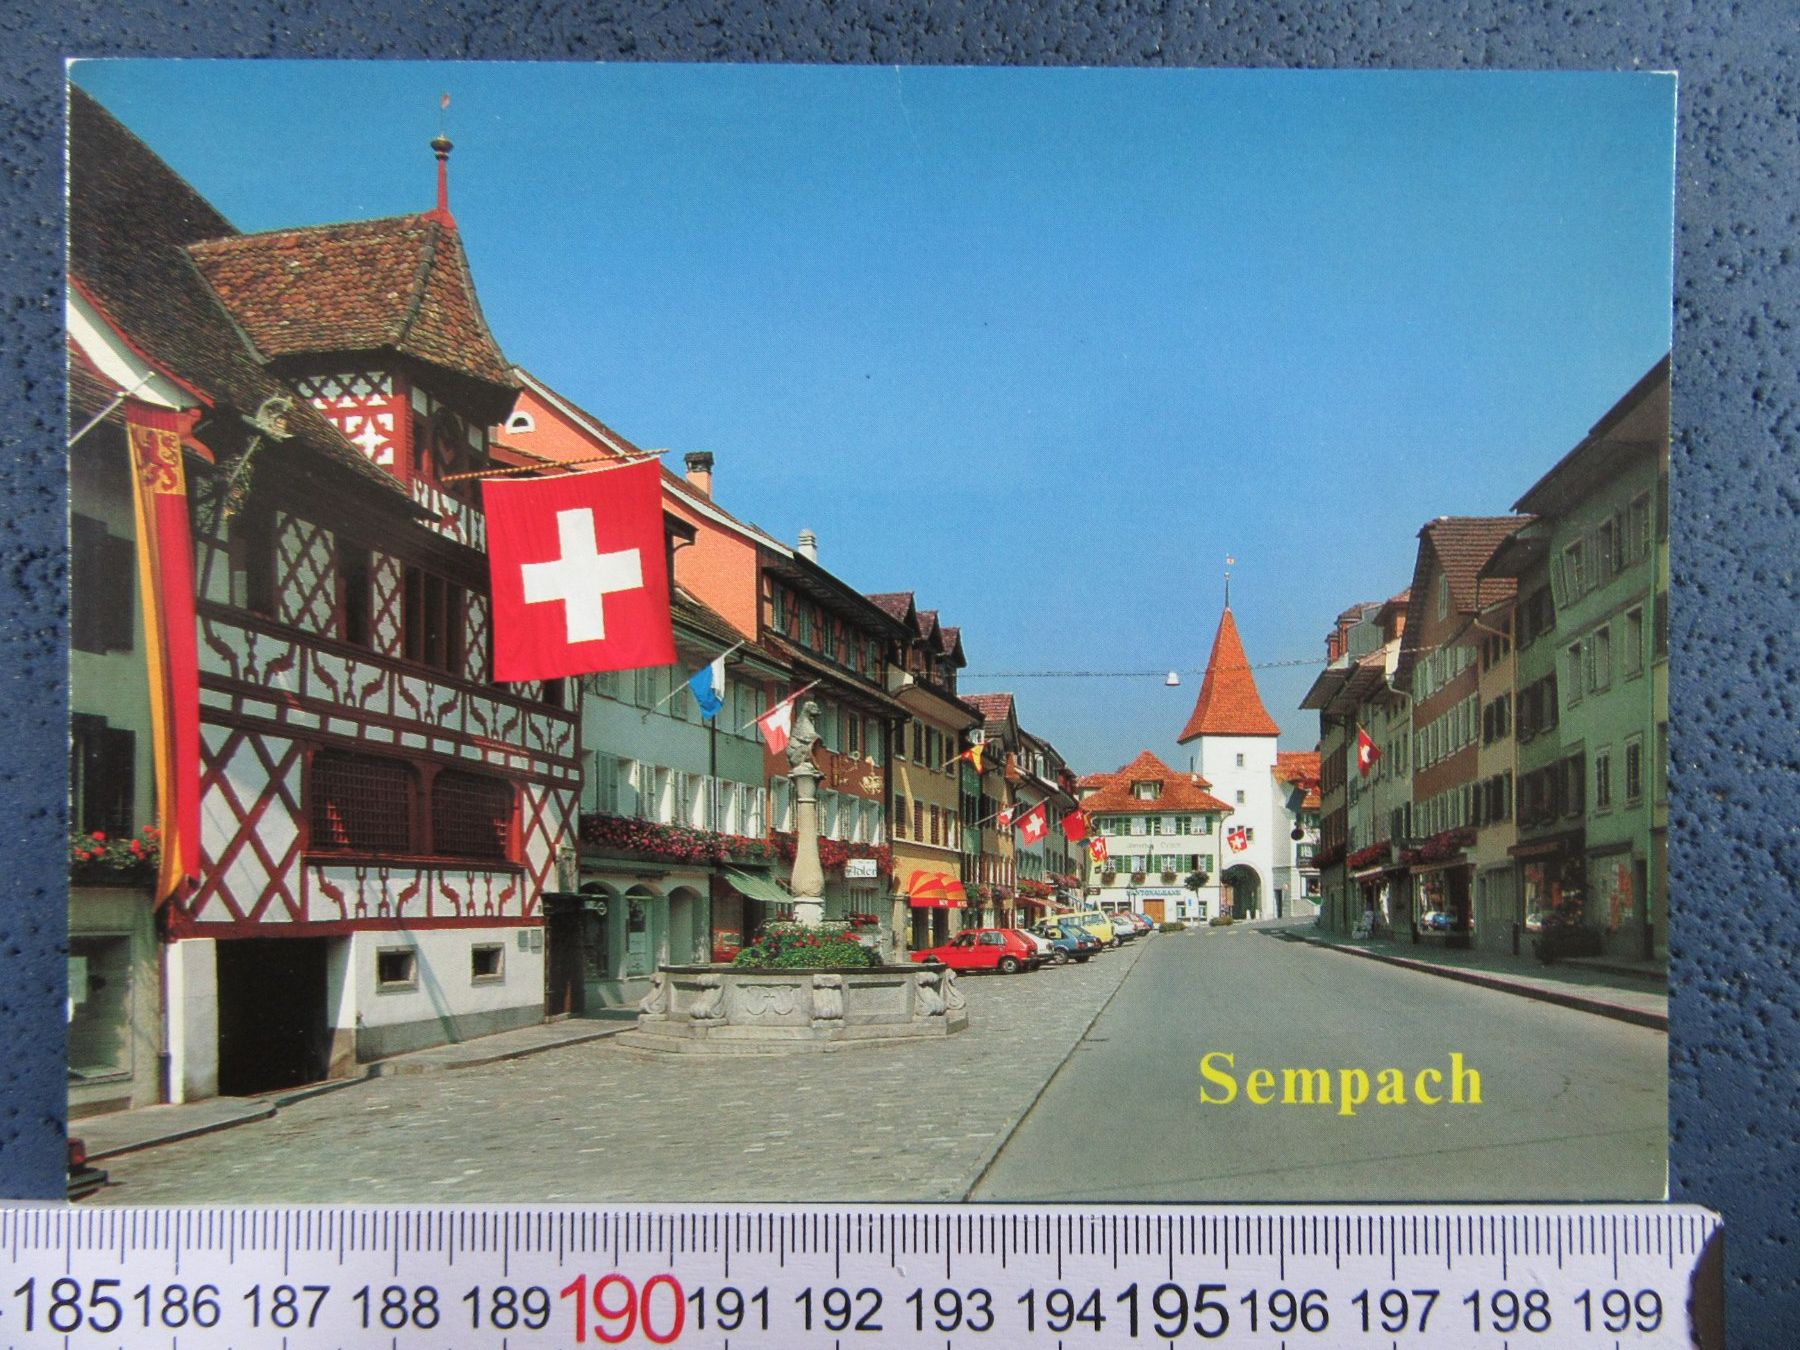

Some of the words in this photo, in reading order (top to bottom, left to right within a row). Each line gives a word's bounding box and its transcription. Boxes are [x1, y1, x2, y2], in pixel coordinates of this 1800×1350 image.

[1199, 1051, 1483, 1116] Sempach
[14, 1277, 123, 1333] 185
[134, 1284, 221, 1328] 186
[243, 1284, 330, 1329] 187
[352, 1285, 440, 1330] 188
[462, 1285, 551, 1331] 189
[560, 1274, 686, 1344] 190
[687, 1286, 769, 1331] 191
[795, 1287, 883, 1332] 192
[905, 1287, 995, 1333] 193
[1017, 1288, 1107, 1333] 194
[1116, 1282, 1230, 1339] 195
[1240, 1288, 1330, 1333] 196
[1351, 1288, 1440, 1333] 197
[1463, 1289, 1552, 1333] 198
[1574, 1289, 1663, 1333] 199
